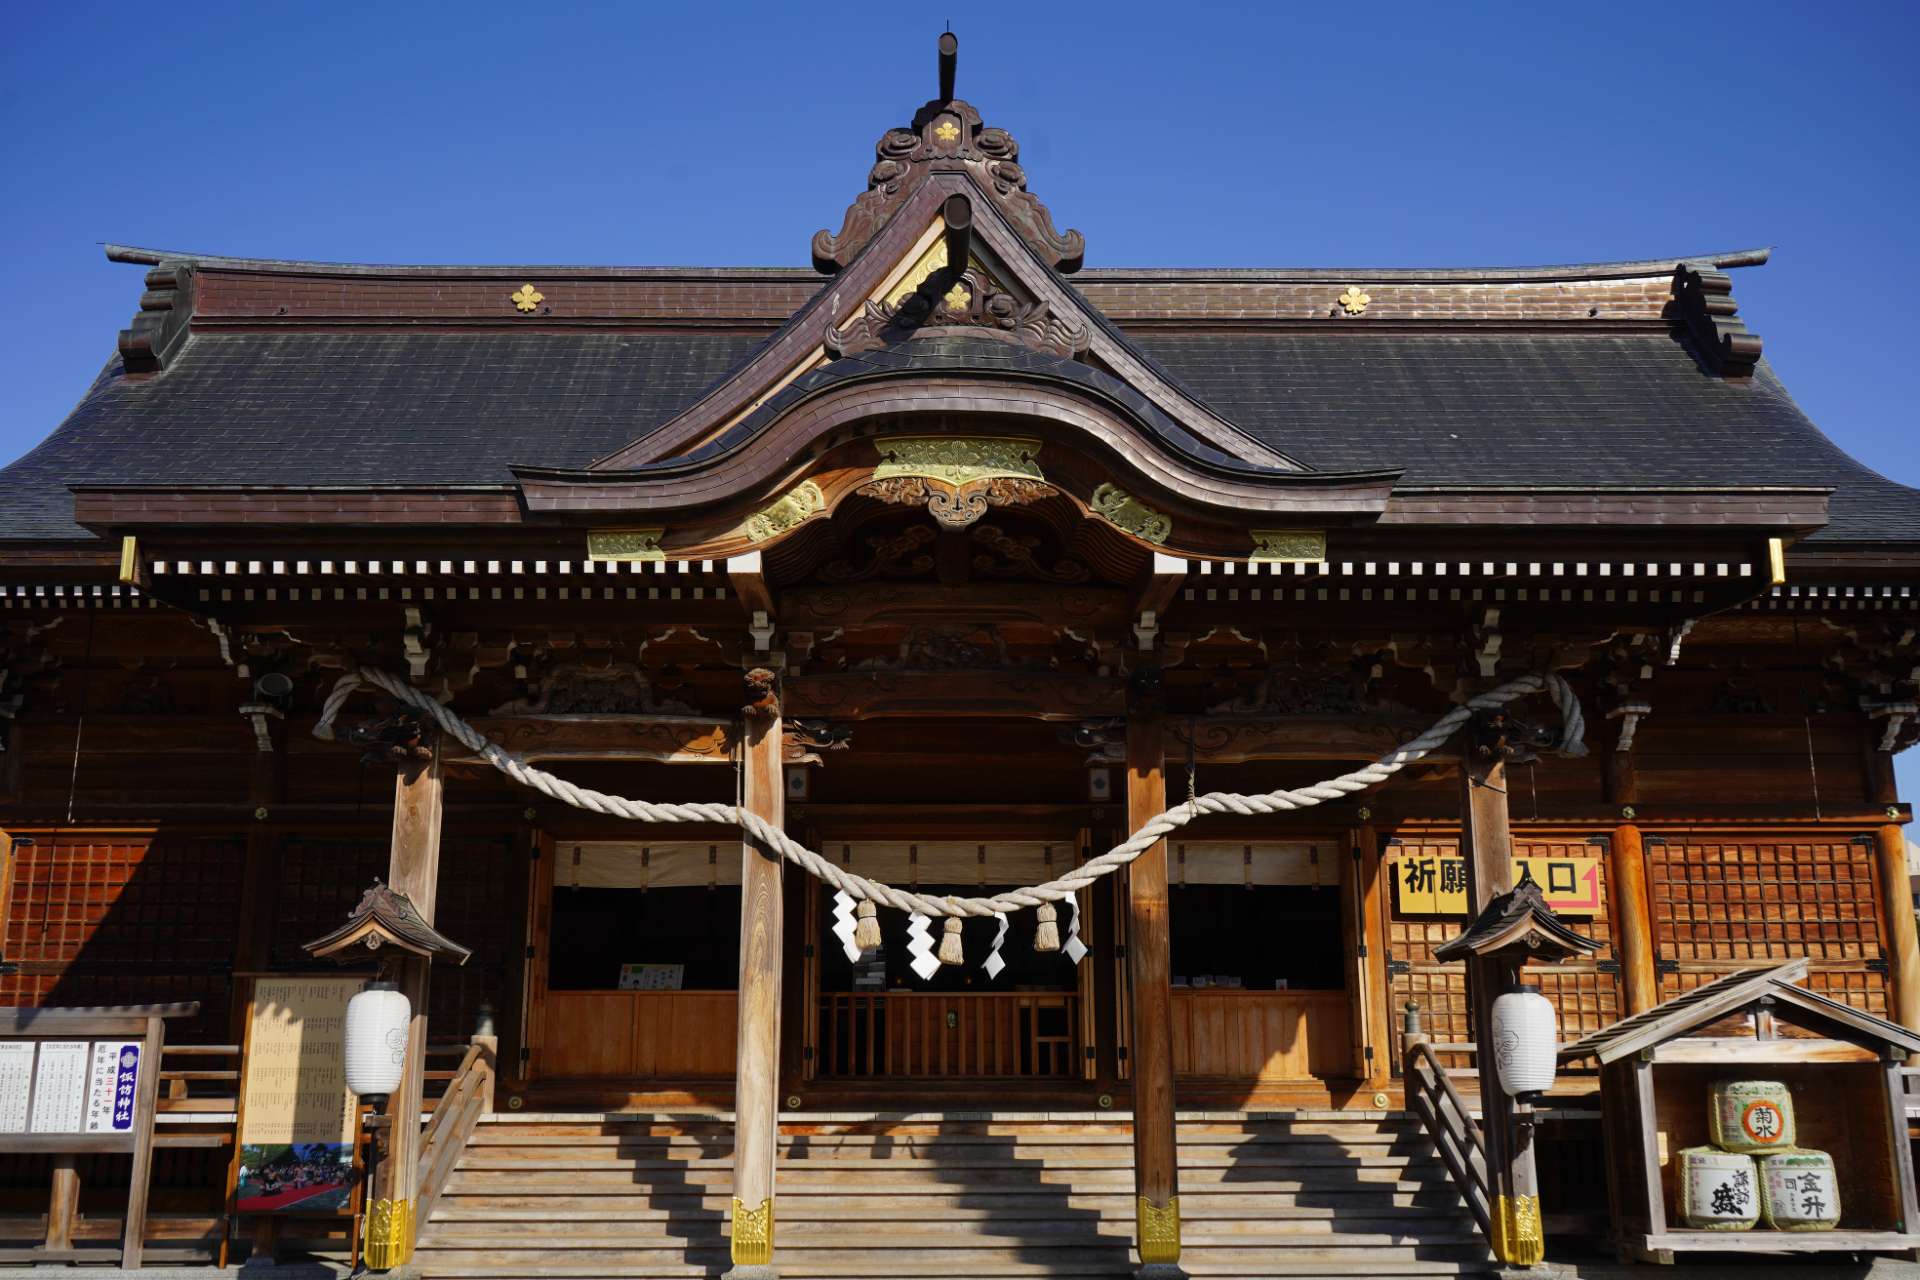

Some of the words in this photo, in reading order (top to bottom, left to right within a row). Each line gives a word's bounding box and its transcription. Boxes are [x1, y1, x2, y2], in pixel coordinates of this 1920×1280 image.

[1404, 857, 1468, 893] 祈願
[1514, 860, 1577, 893] 入口
[102, 1052, 117, 1114] 平成三十一年
[116, 1072, 135, 1121] 諏訪神社
[1755, 1107, 1776, 1138] 菊水
